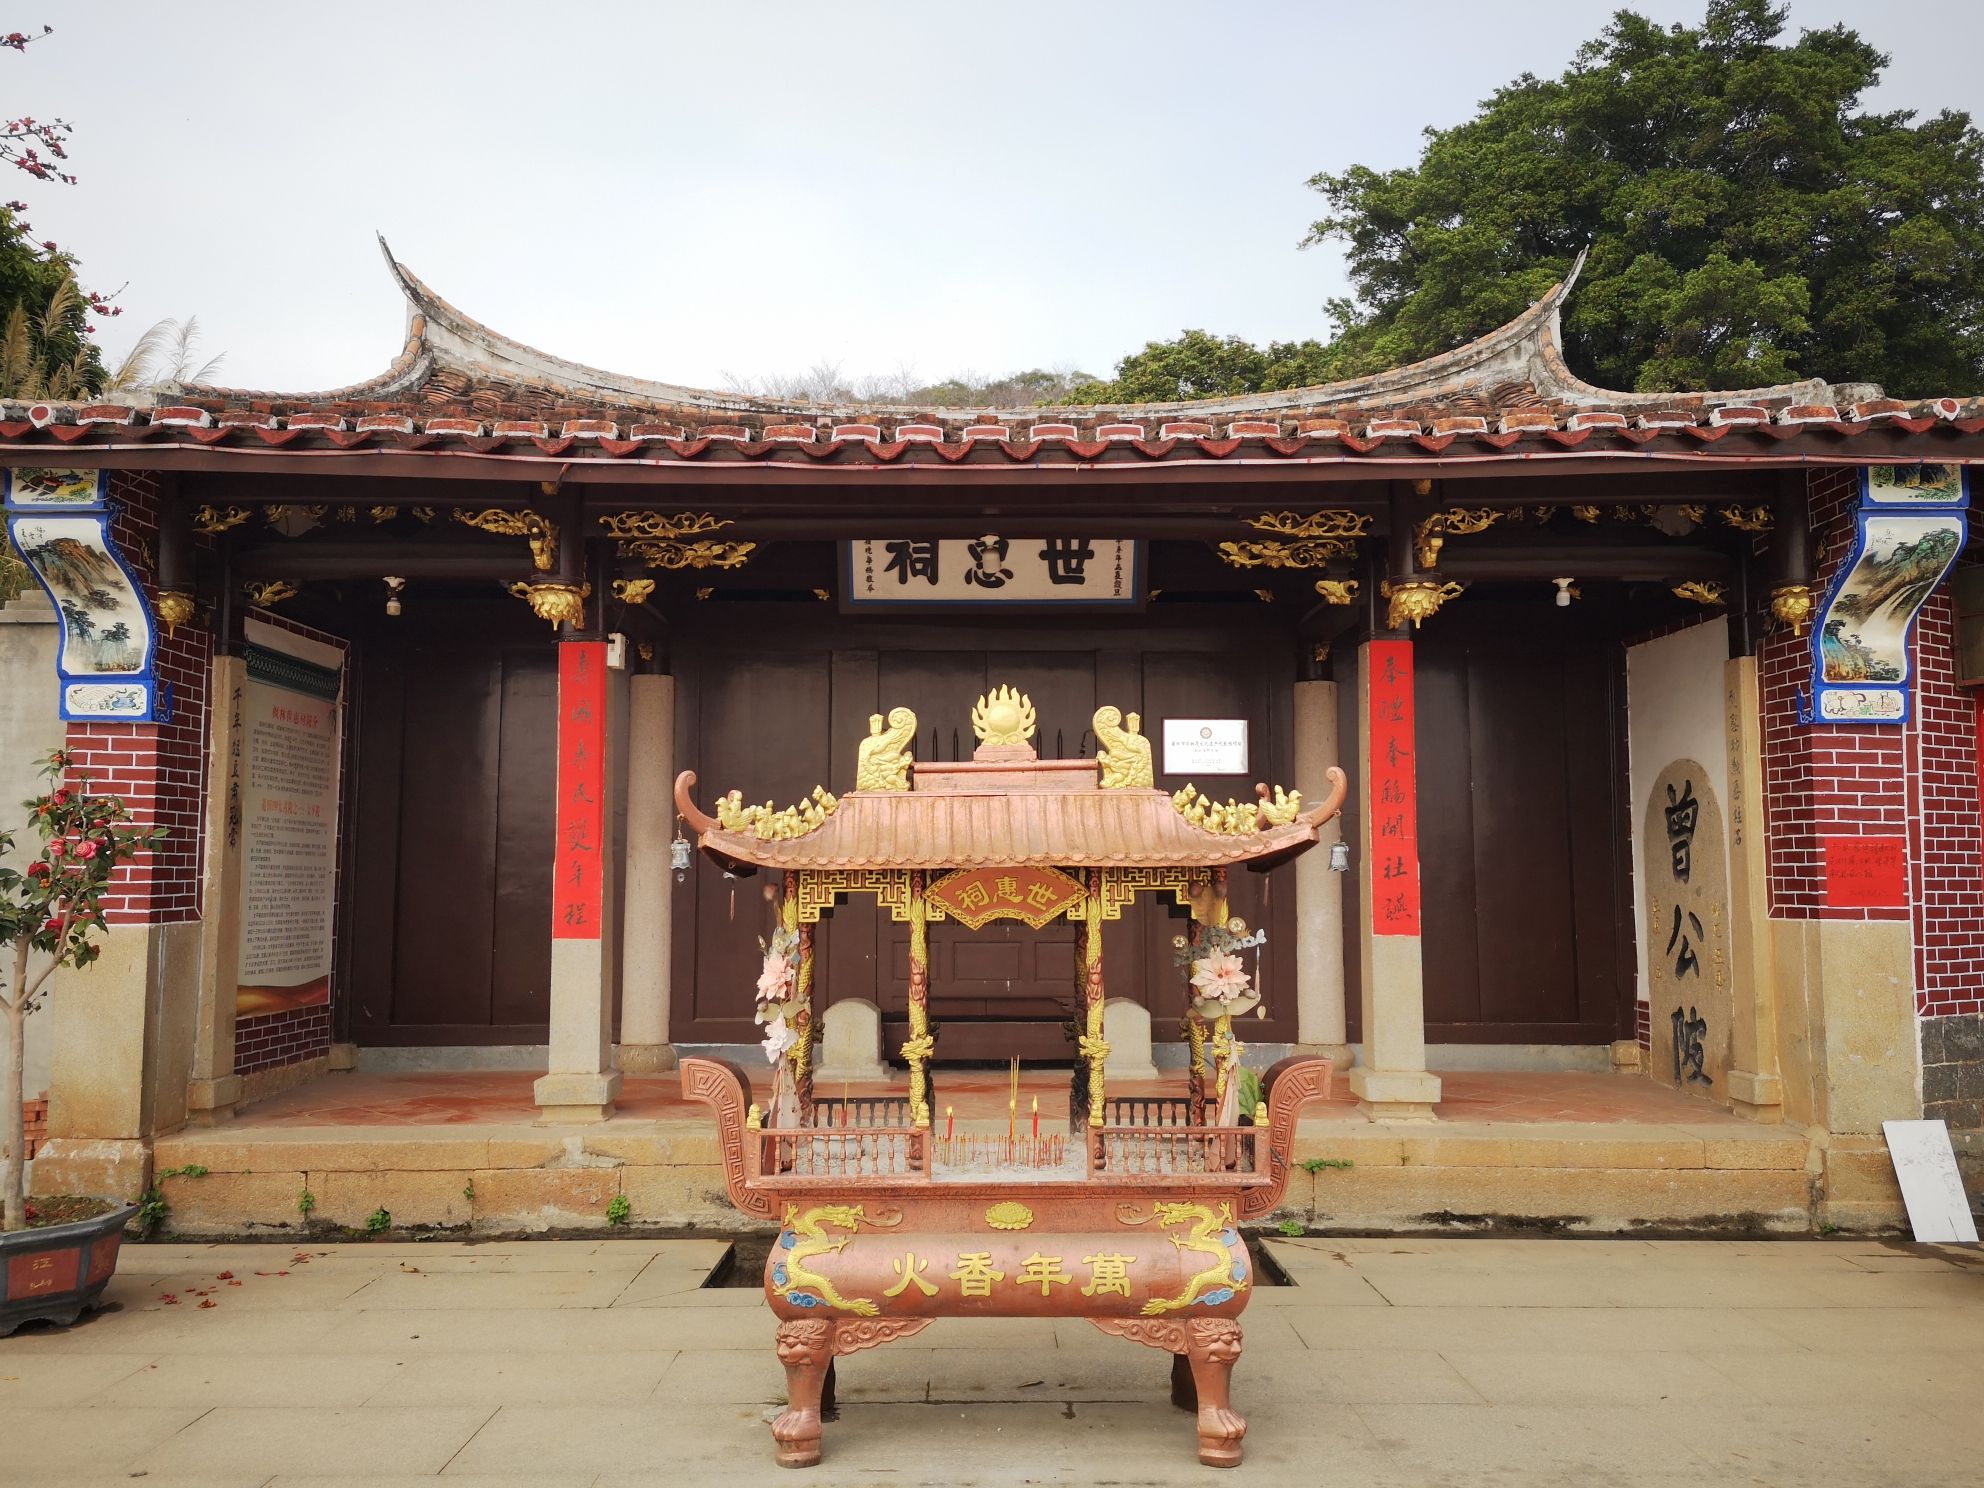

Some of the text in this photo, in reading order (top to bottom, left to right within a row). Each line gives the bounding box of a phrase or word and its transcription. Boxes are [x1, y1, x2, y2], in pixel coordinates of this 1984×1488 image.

[955, 876, 1059, 912] 世惠祠
[884, 1250, 1137, 1298] 萬年香火
